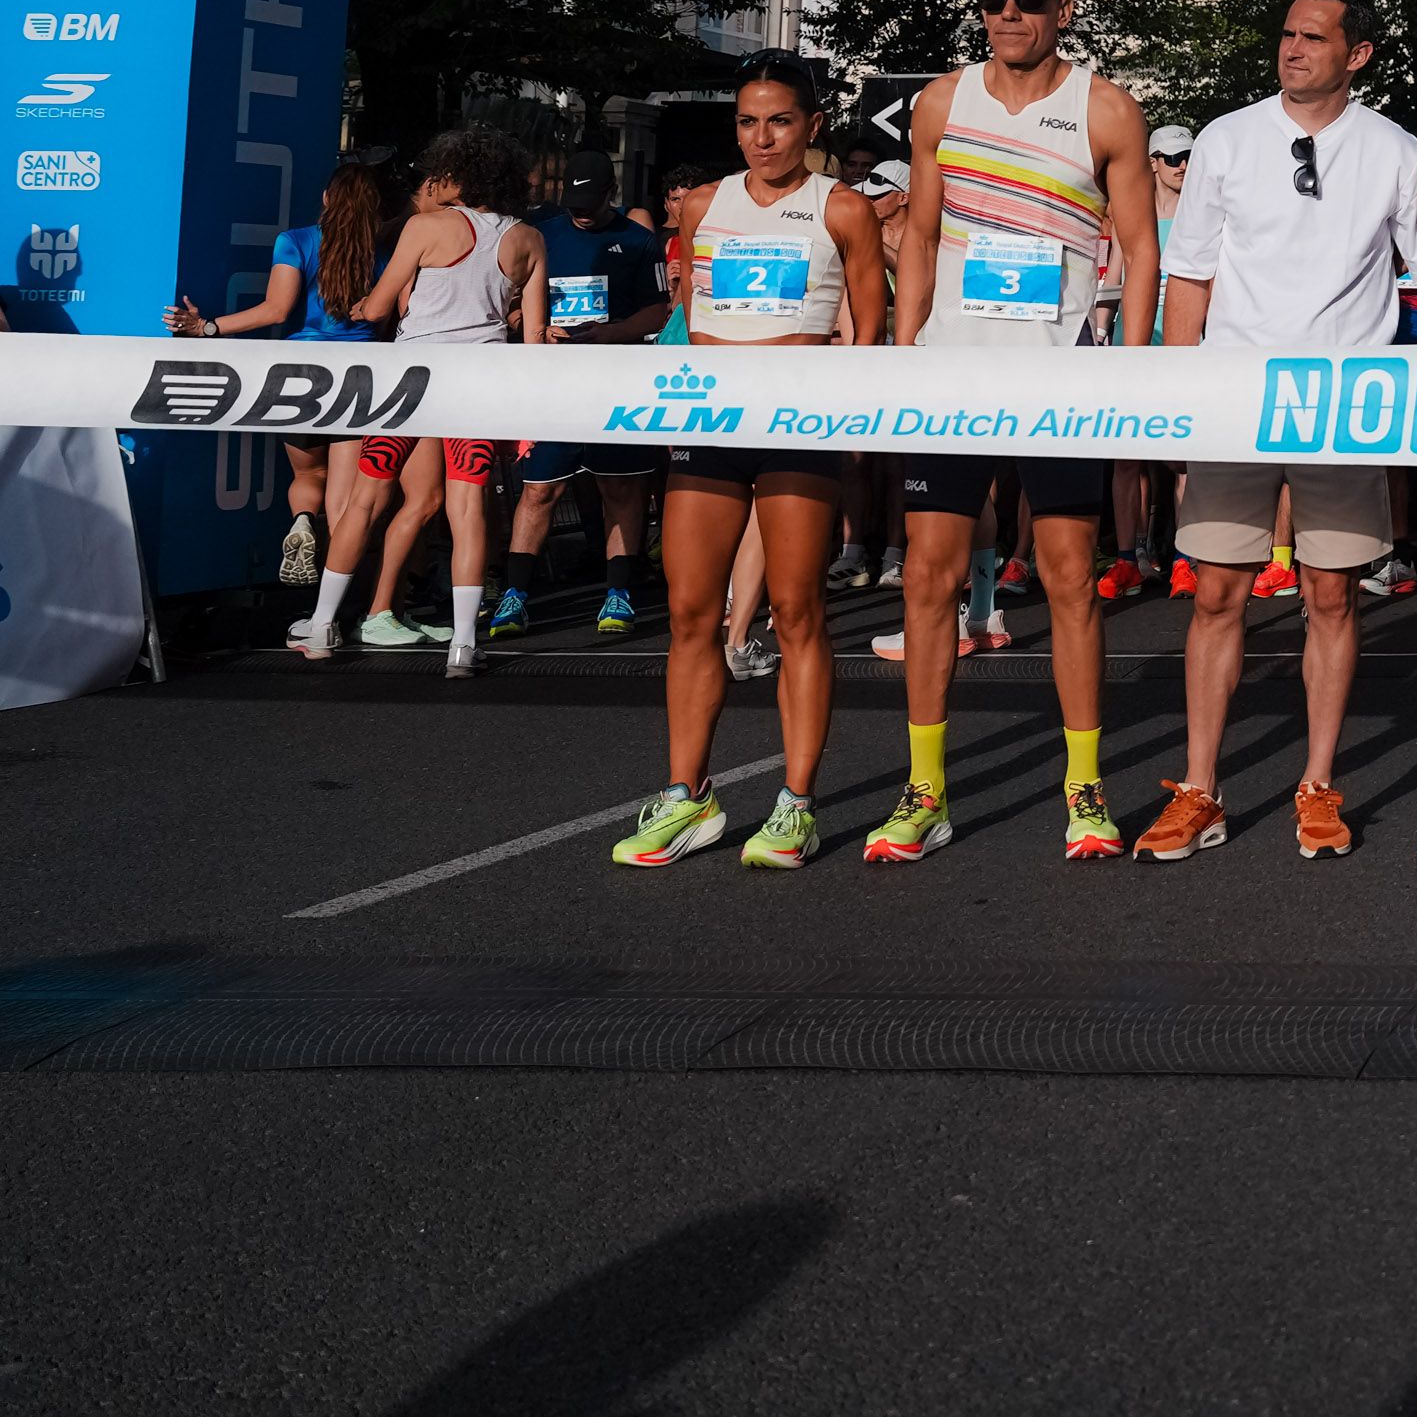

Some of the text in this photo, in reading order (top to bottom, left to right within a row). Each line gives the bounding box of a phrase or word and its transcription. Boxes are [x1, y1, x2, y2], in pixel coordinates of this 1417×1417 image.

[59, 13, 121, 41] BM
[15, 107, 105, 119] SKECHERS
[1039, 116, 1078, 133] HOKA
[23, 153, 67, 171] SANI
[21, 171, 96, 188] CENTRO
[780, 209, 814, 222] HOKA
[746, 266, 768, 292] 2
[1000, 269, 1021, 295] 3
[19, 288, 85, 303] TOTEEMI
[554, 295, 606, 313] 1714
[231, 362, 432, 430] BM
[602, 406, 1194, 439] KLM Royal Dutch Airlines
